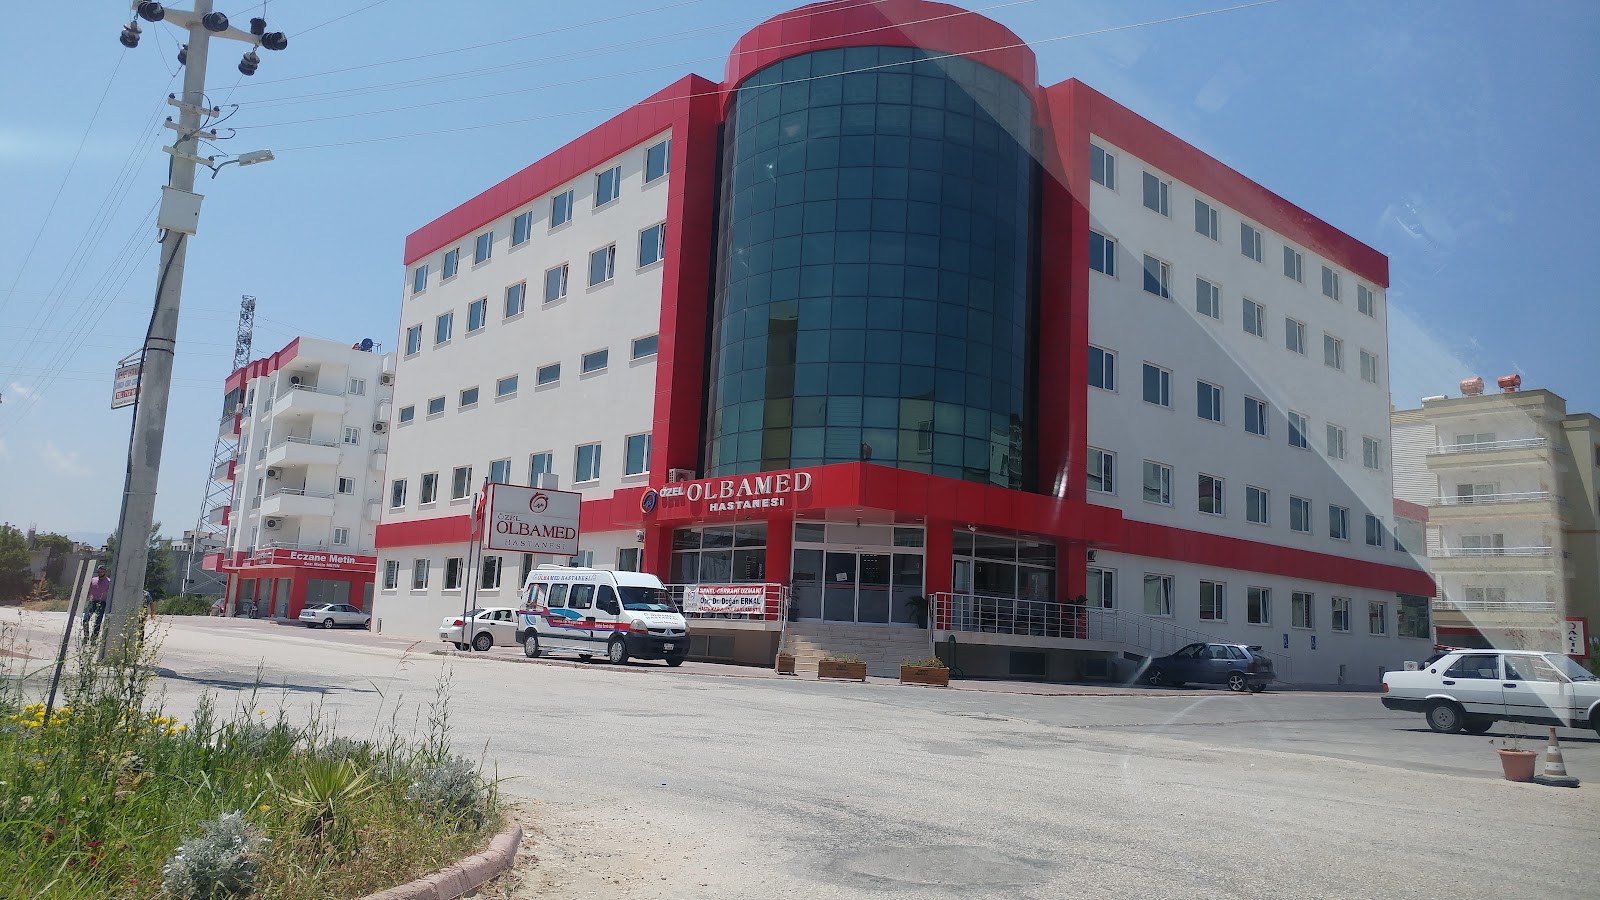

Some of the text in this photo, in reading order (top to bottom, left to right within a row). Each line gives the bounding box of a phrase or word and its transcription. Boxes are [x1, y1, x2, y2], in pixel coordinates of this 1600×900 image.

[659, 472, 812, 502] ÖZEL OLBAMED
[497, 513, 521, 522] ÖZEL
[496, 520, 576, 540] OLBAMED
[290, 551, 355, 564] Eczane Metin
[721, 597, 740, 607] Doğan
[740, 597, 761, 605] ERKAL
